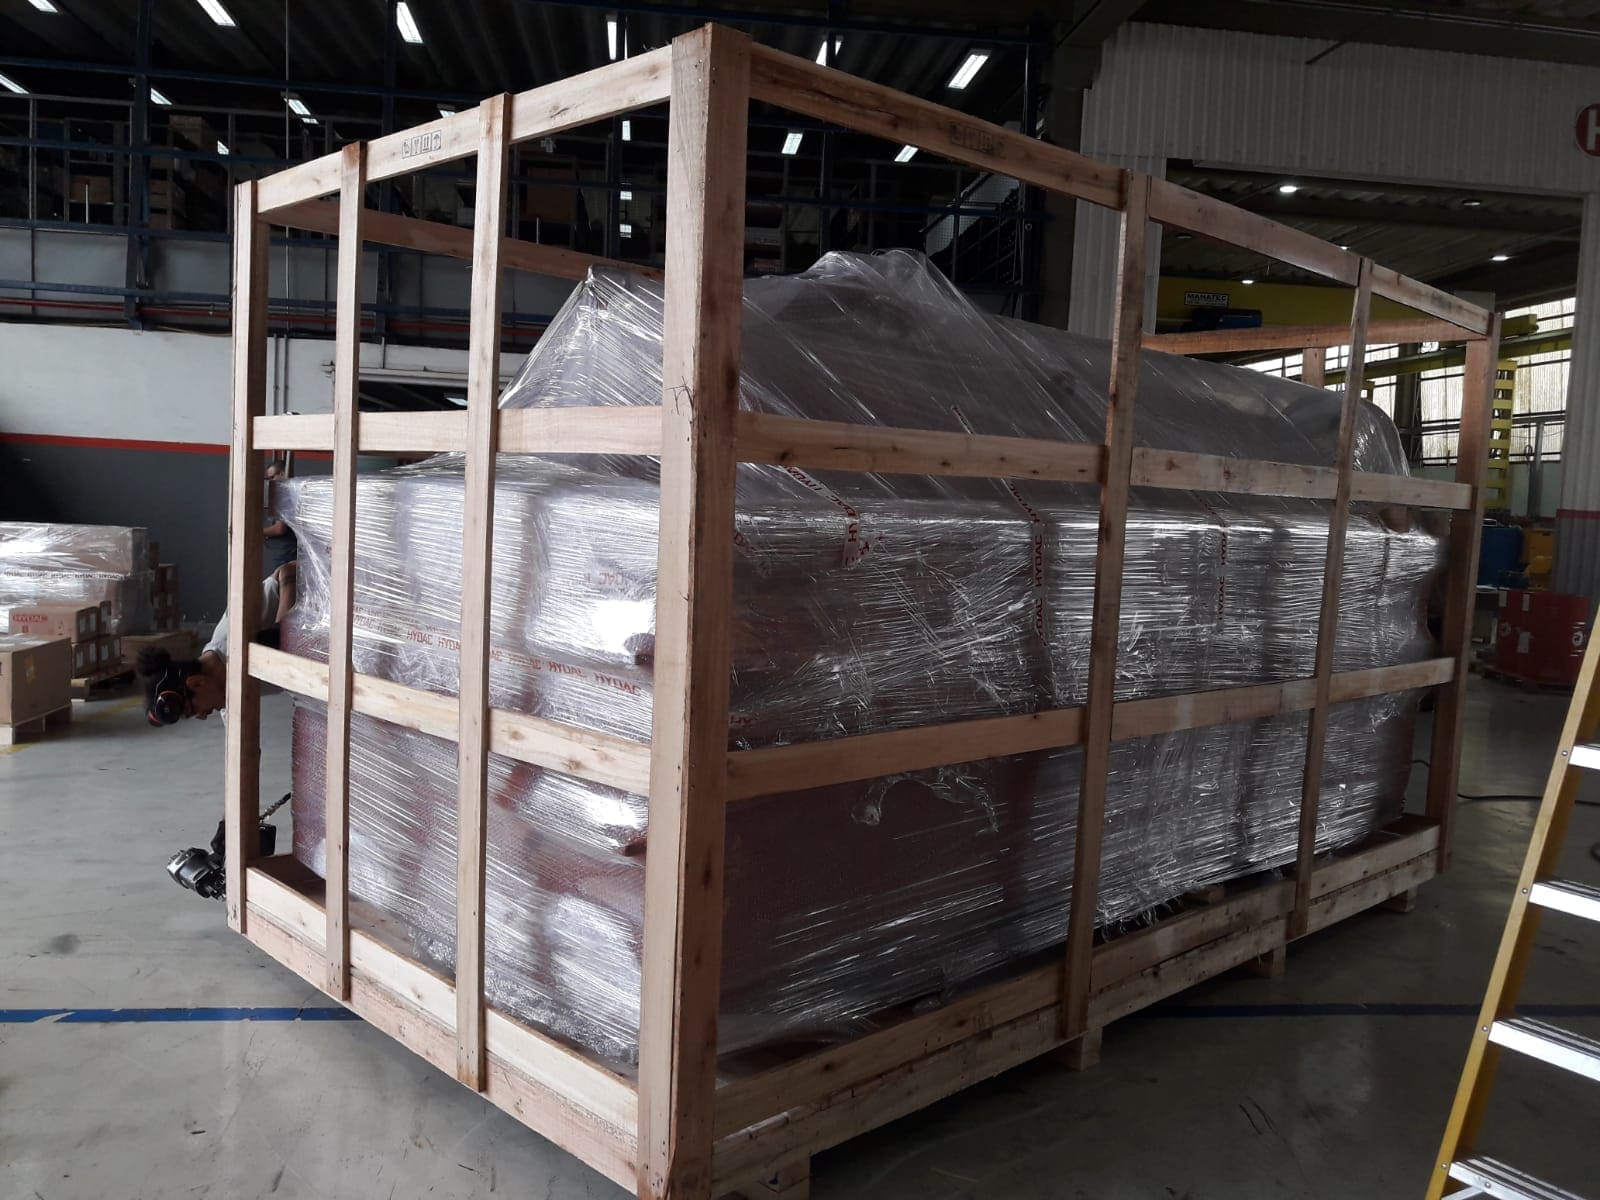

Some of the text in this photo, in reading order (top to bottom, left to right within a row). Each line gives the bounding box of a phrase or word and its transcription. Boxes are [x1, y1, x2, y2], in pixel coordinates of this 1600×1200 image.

[1187, 293, 1228, 301] MANATEC
[1034, 535, 1043, 587] HYDAC
[1217, 576, 1225, 620] HYDAC
[406, 630, 433, 646] HYDAC
[438, 636, 461, 652] HYDA
[594, 672, 642, 696] HYDAC
